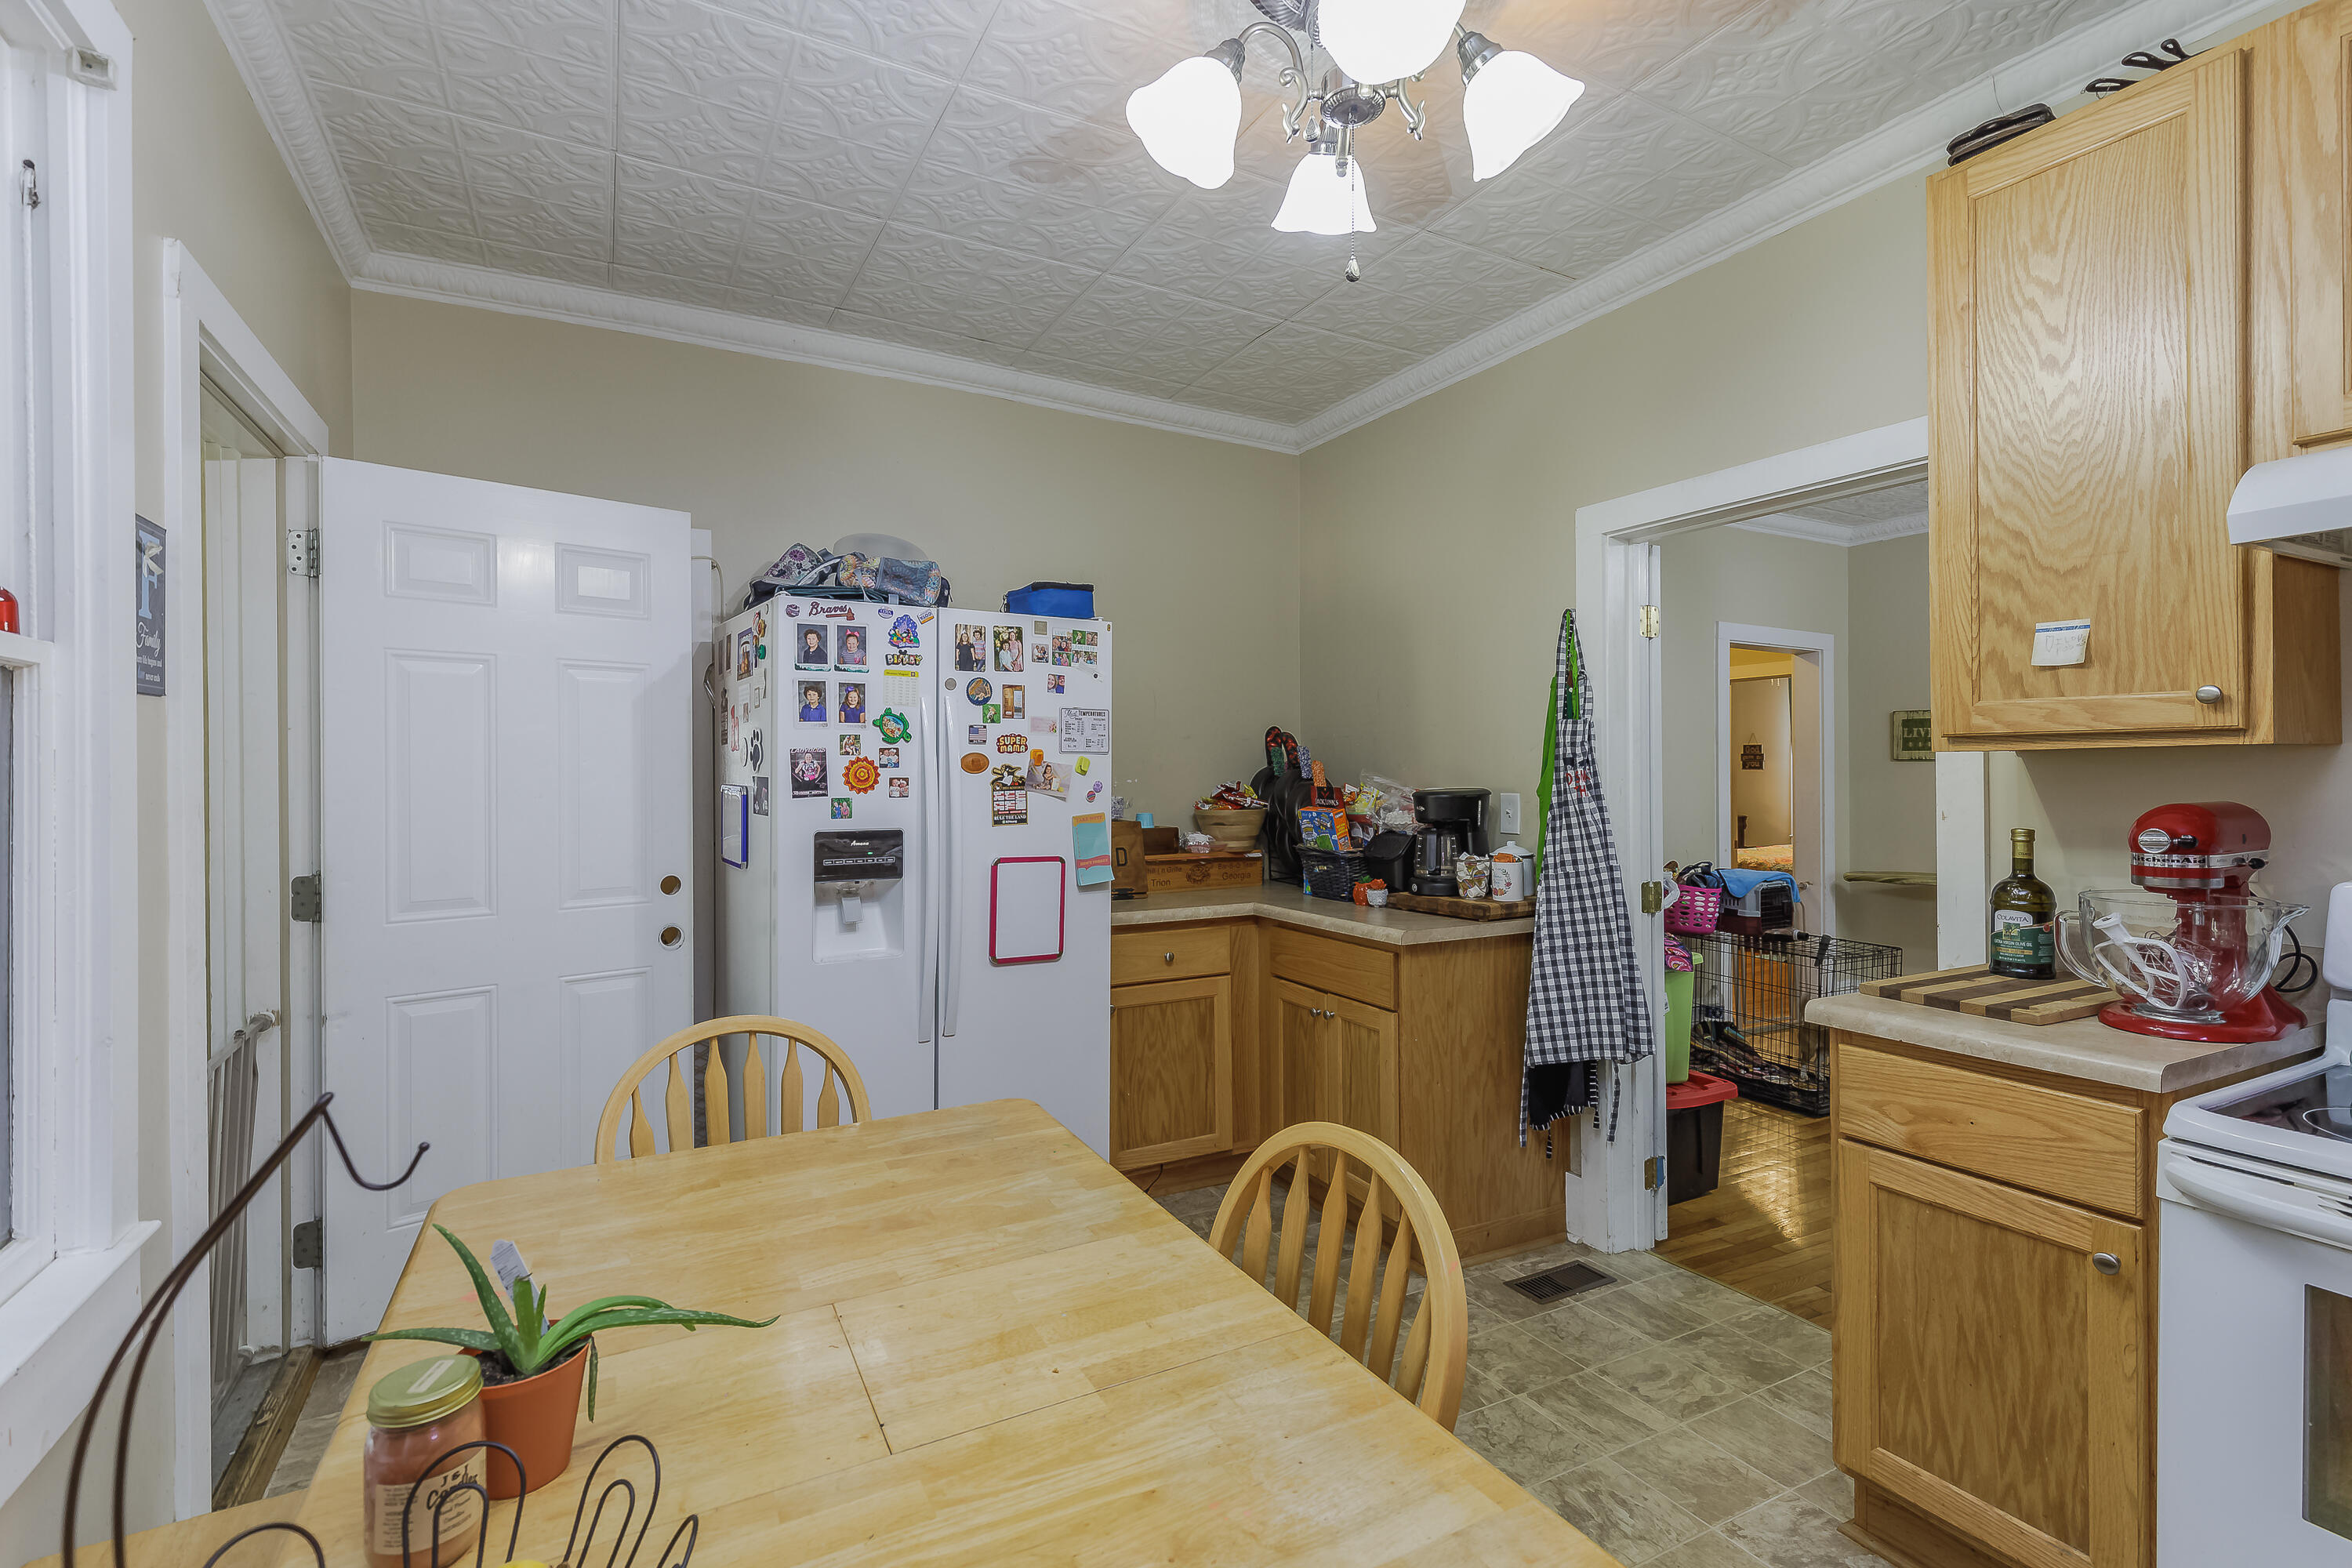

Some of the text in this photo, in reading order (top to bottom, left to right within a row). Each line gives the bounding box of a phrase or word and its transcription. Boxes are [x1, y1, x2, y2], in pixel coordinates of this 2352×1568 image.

[808, 601, 848, 616] Braves
[136, 622, 161, 657] Family
[999, 736, 1027, 746] SUPER
[1000, 744, 1025, 753] MAMA
[1115, 848, 1128, 867] D
[2132, 853, 2207, 864] KitchenAid
[1221, 872, 1252, 881] Georgia
[1151, 879, 1171, 887] Trion
[1996, 913, 2029, 923] COLAVITA
